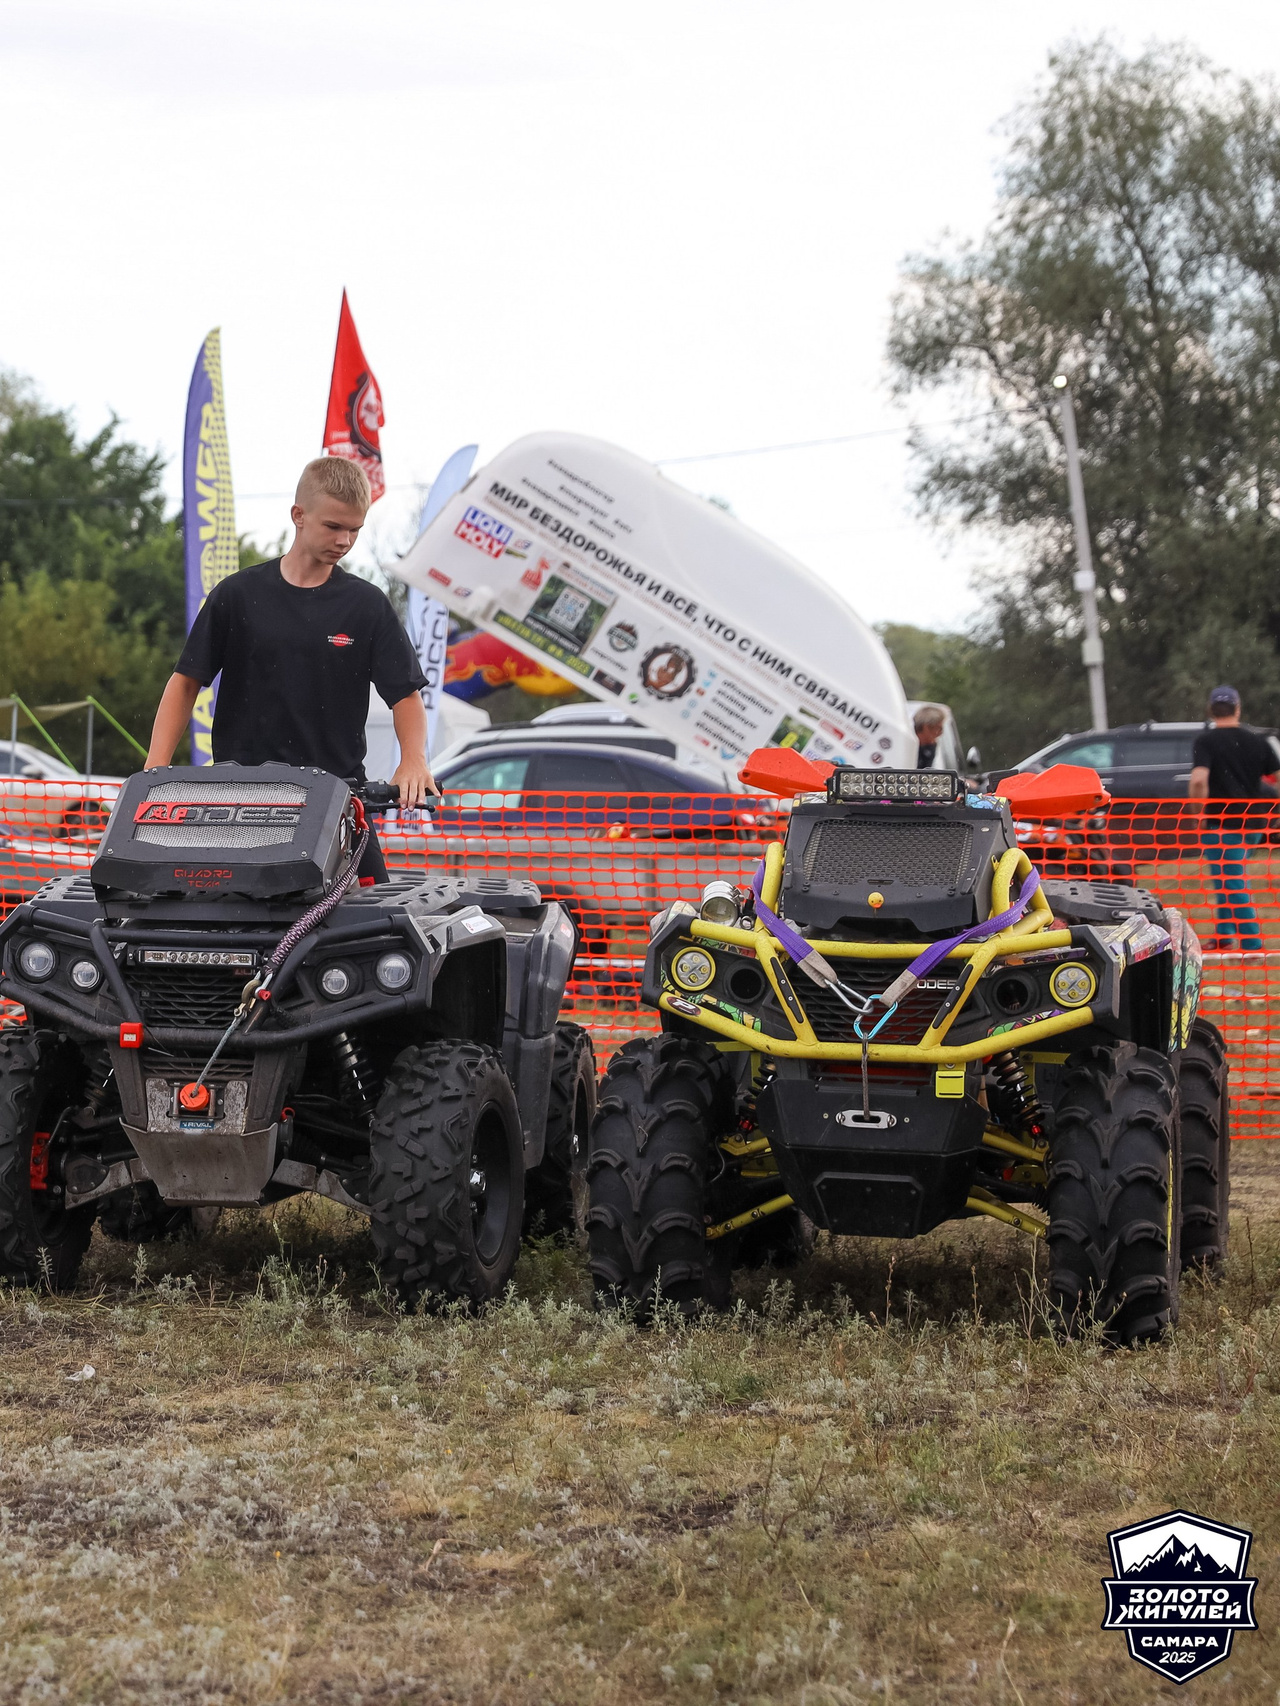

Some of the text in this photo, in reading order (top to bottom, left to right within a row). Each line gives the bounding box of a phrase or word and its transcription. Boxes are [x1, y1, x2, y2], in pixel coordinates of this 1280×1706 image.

[457, 522, 504, 558] MOLY
[465, 507, 512, 543] LIQUI
[489, 481, 529, 510] МИР
[529, 506, 647, 587] БЕЗДОРОЖЬЯ
[647, 580, 662, 595] И
[705, 614, 736, 641] ЧТО
[738, 638, 752, 651] С
[752, 647, 793, 678] НИМ
[793, 673, 880, 734] СВЯЗАНО!
[422, 610, 445, 710] РОСС
[174, 869, 233, 879] QUADRO
[187, 880, 221, 888] TEAM
[915, 979, 958, 990] ODES
